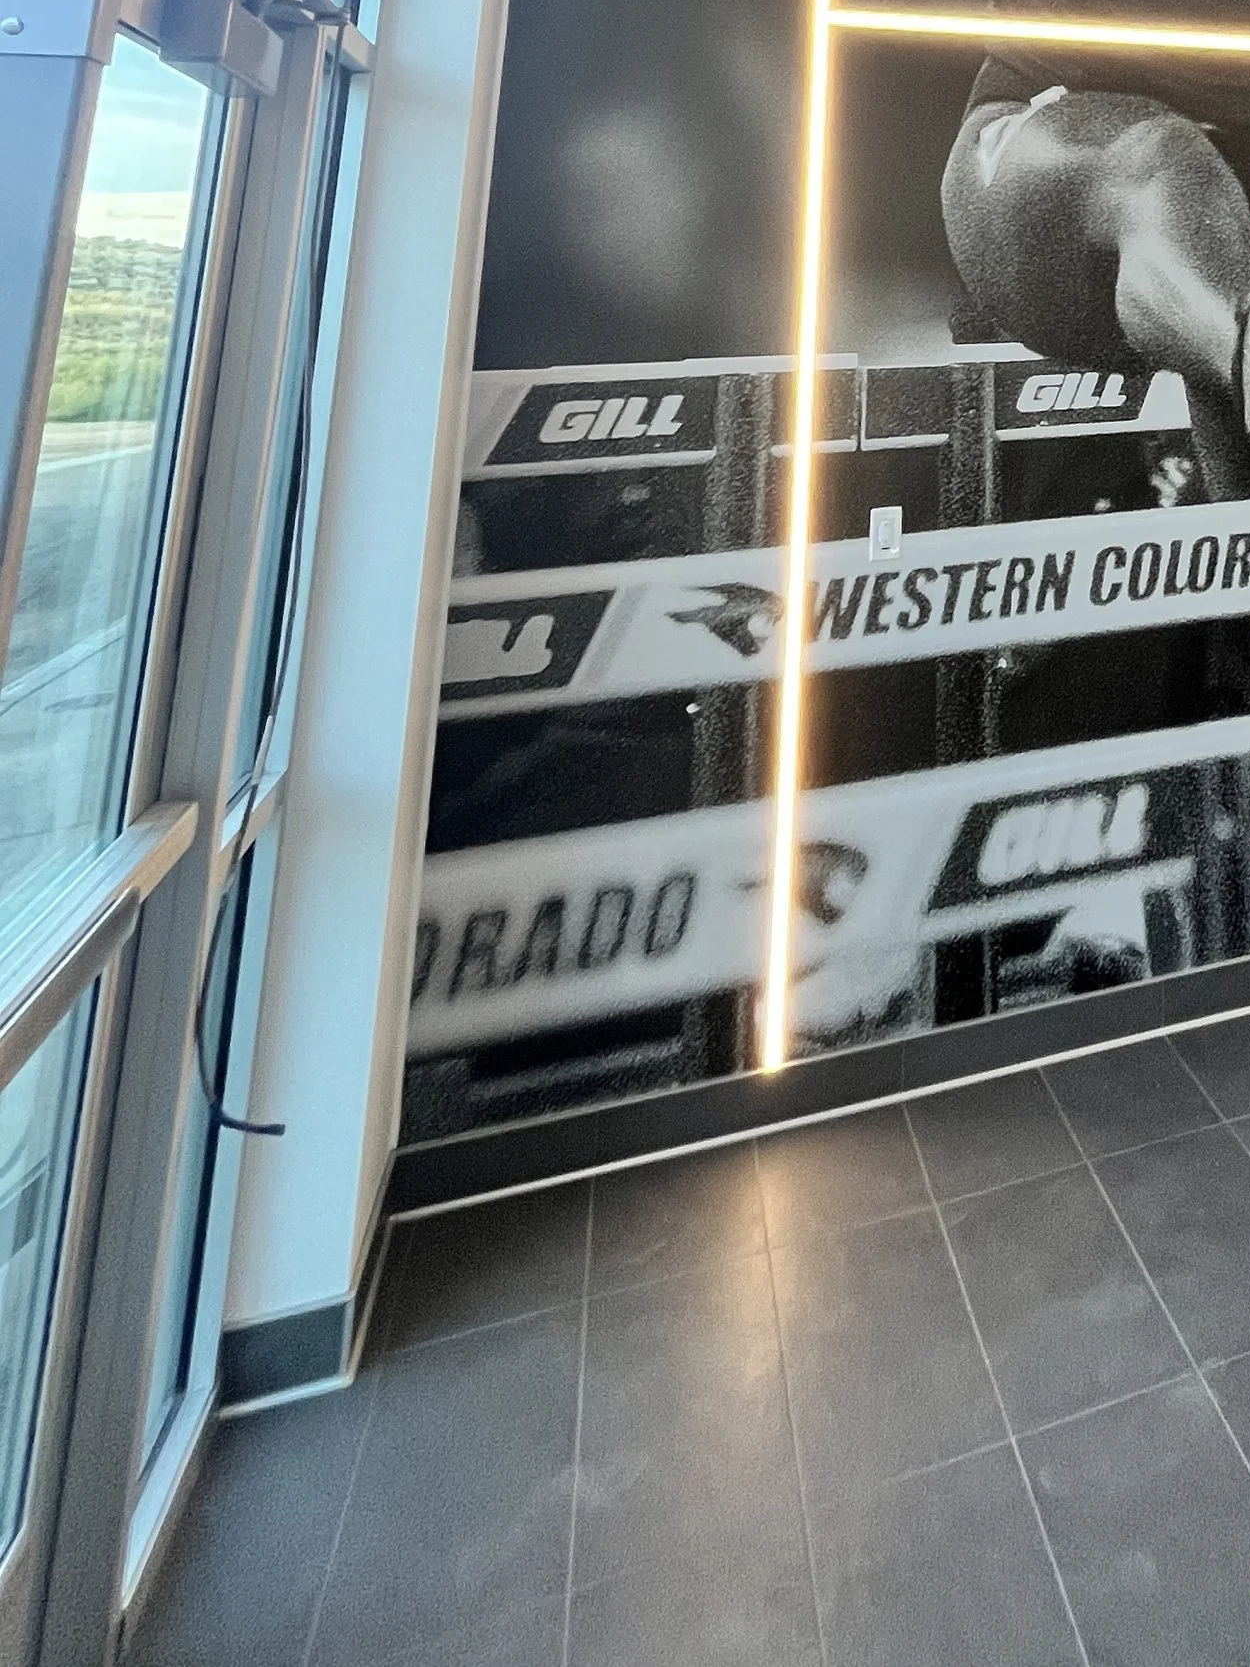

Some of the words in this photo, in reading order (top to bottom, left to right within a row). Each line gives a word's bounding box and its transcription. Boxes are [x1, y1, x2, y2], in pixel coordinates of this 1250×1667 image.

[1016, 371, 1127, 414] GILL
[539, 394, 684, 443] GILL
[802, 550, 1077, 643] WESTERN
